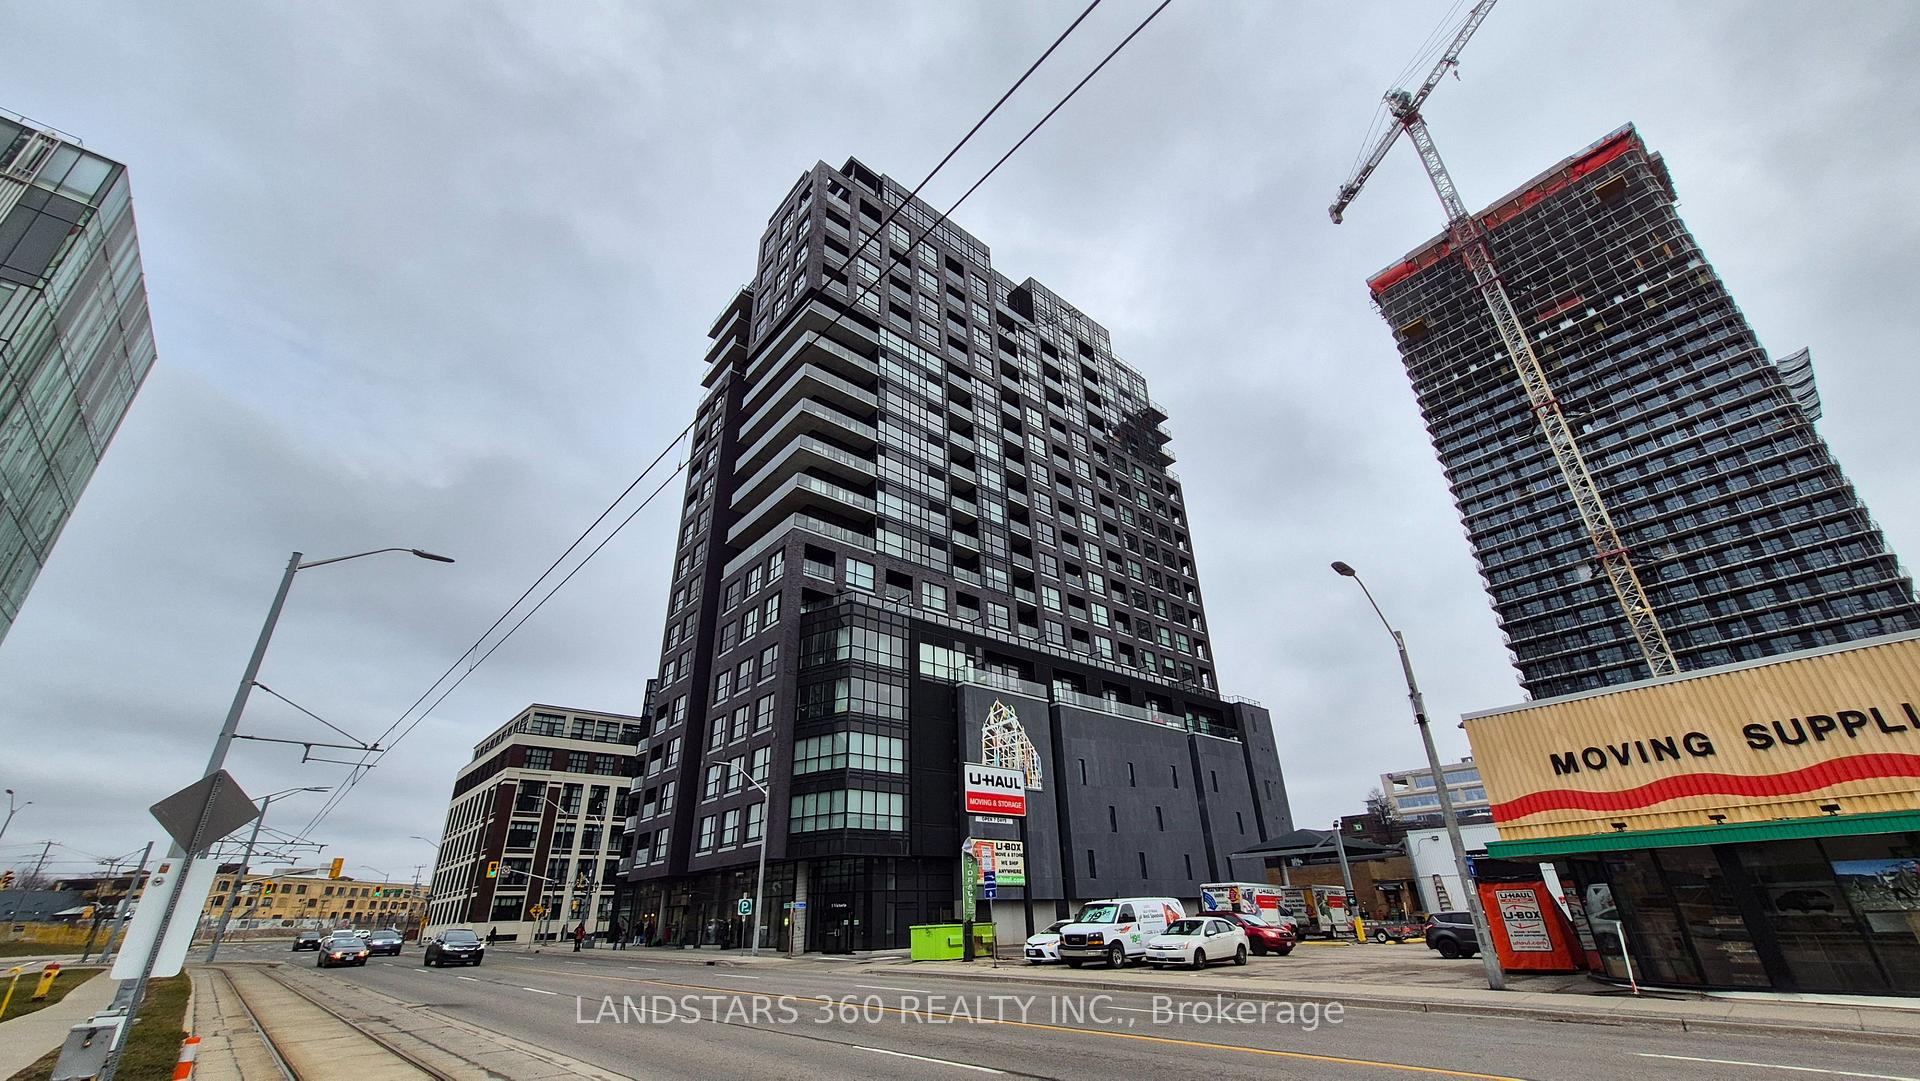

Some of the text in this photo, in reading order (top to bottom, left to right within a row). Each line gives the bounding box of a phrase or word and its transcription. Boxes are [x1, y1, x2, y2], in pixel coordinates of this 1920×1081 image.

[1550, 702, 1920, 776] MOVING SUPPLI
[969, 772, 1021, 789] U-HAUL
[969, 798, 992, 806] MOVING
[998, 800, 1022, 809] STORAGE
[996, 843, 1021, 851] U-BOX
[1503, 911, 1541, 919] U-BOX
